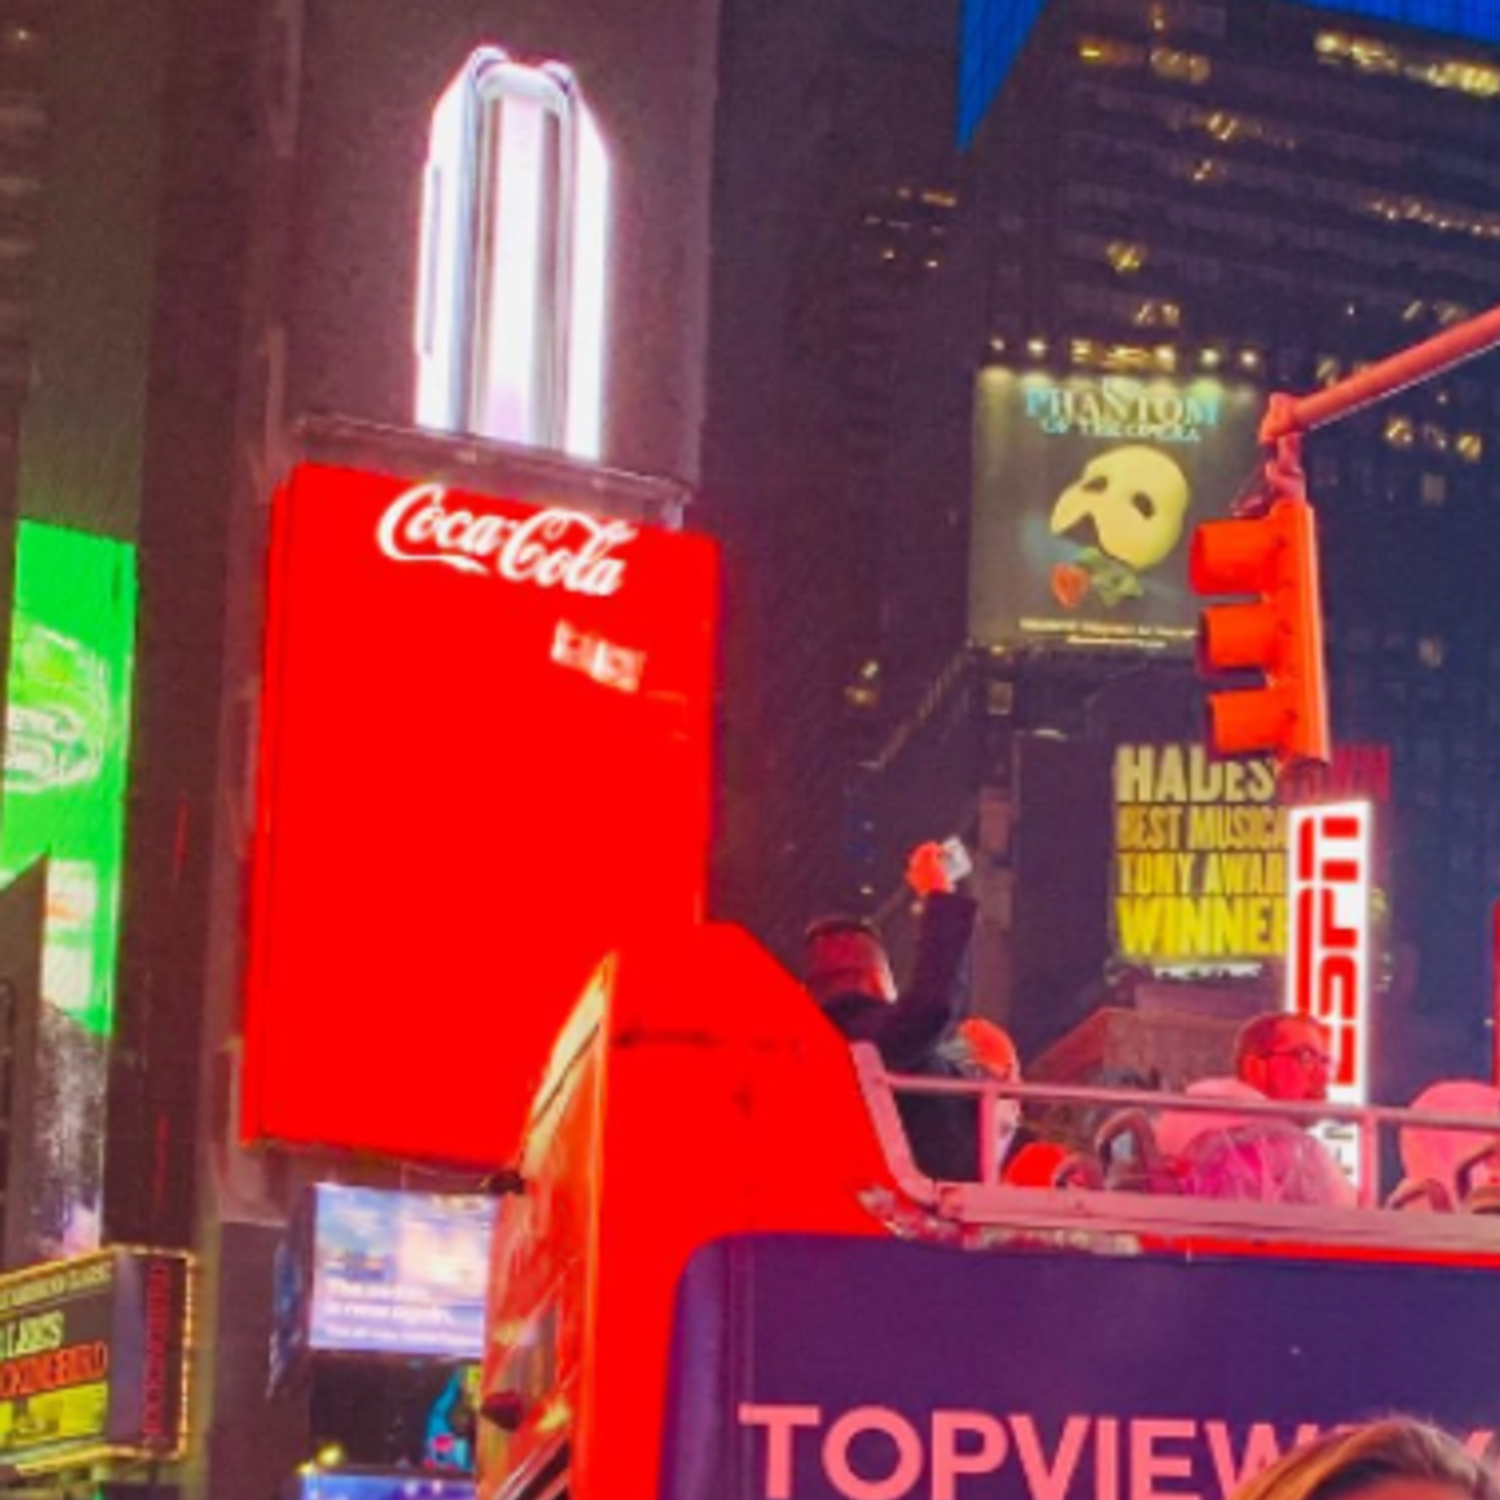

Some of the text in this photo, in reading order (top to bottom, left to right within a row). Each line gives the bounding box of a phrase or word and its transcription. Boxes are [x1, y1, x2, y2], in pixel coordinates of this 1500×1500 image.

[1026, 382, 1222, 428] PHANTOM
[377, 483, 638, 596] Coca-Cola
[1116, 804, 1288, 850] BEST MUSICA
[1116, 852, 1288, 895] TONY AWAR
[1117, 897, 1288, 957] WINNE
